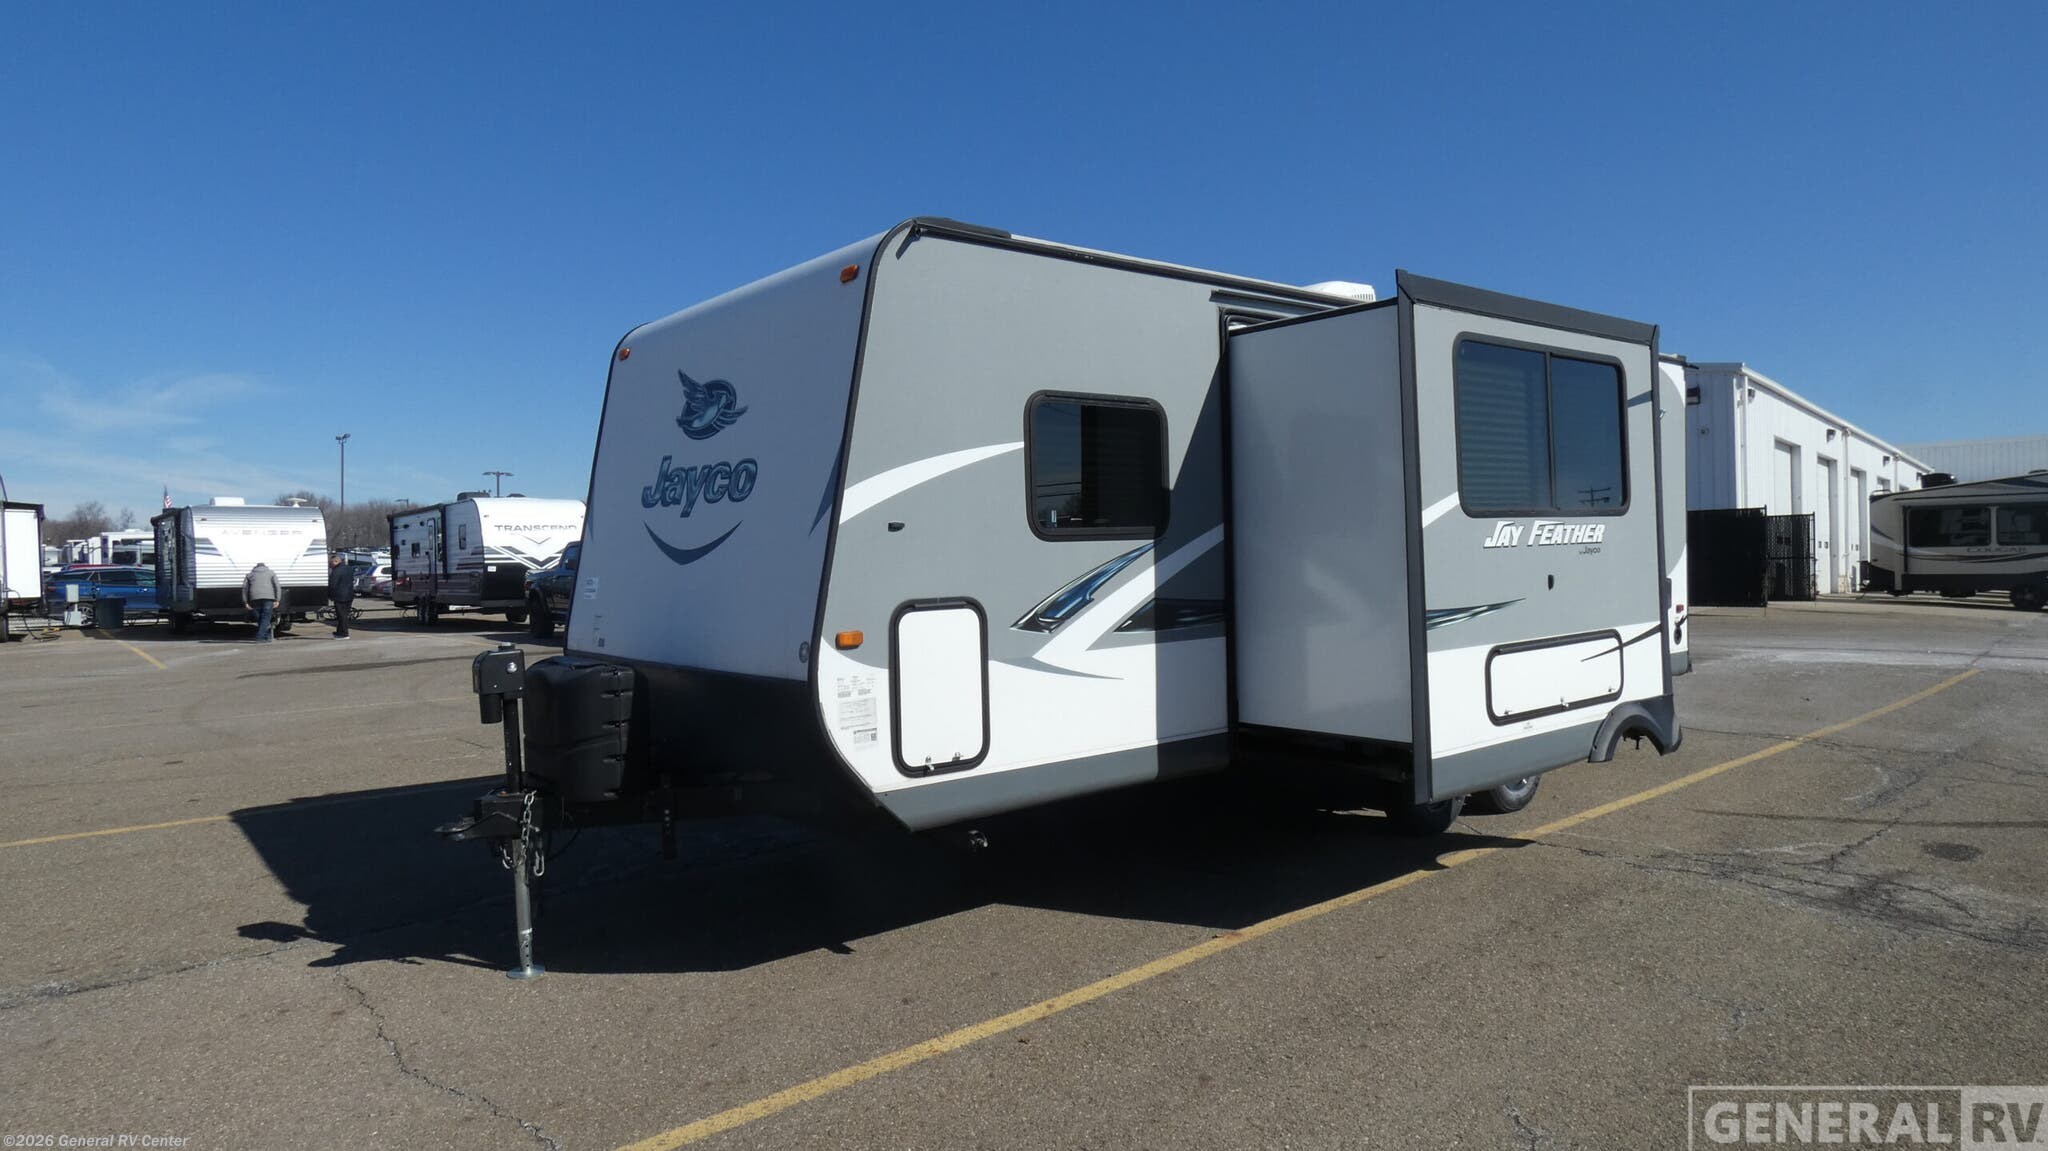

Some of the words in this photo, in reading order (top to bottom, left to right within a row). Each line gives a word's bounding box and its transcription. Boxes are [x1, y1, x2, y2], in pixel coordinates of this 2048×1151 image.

[641, 455, 758, 518] Jayco
[494, 524, 577, 532] TRANSCEND
[1483, 520, 1524, 548] JAY
[1527, 520, 1606, 546] FEATHER
